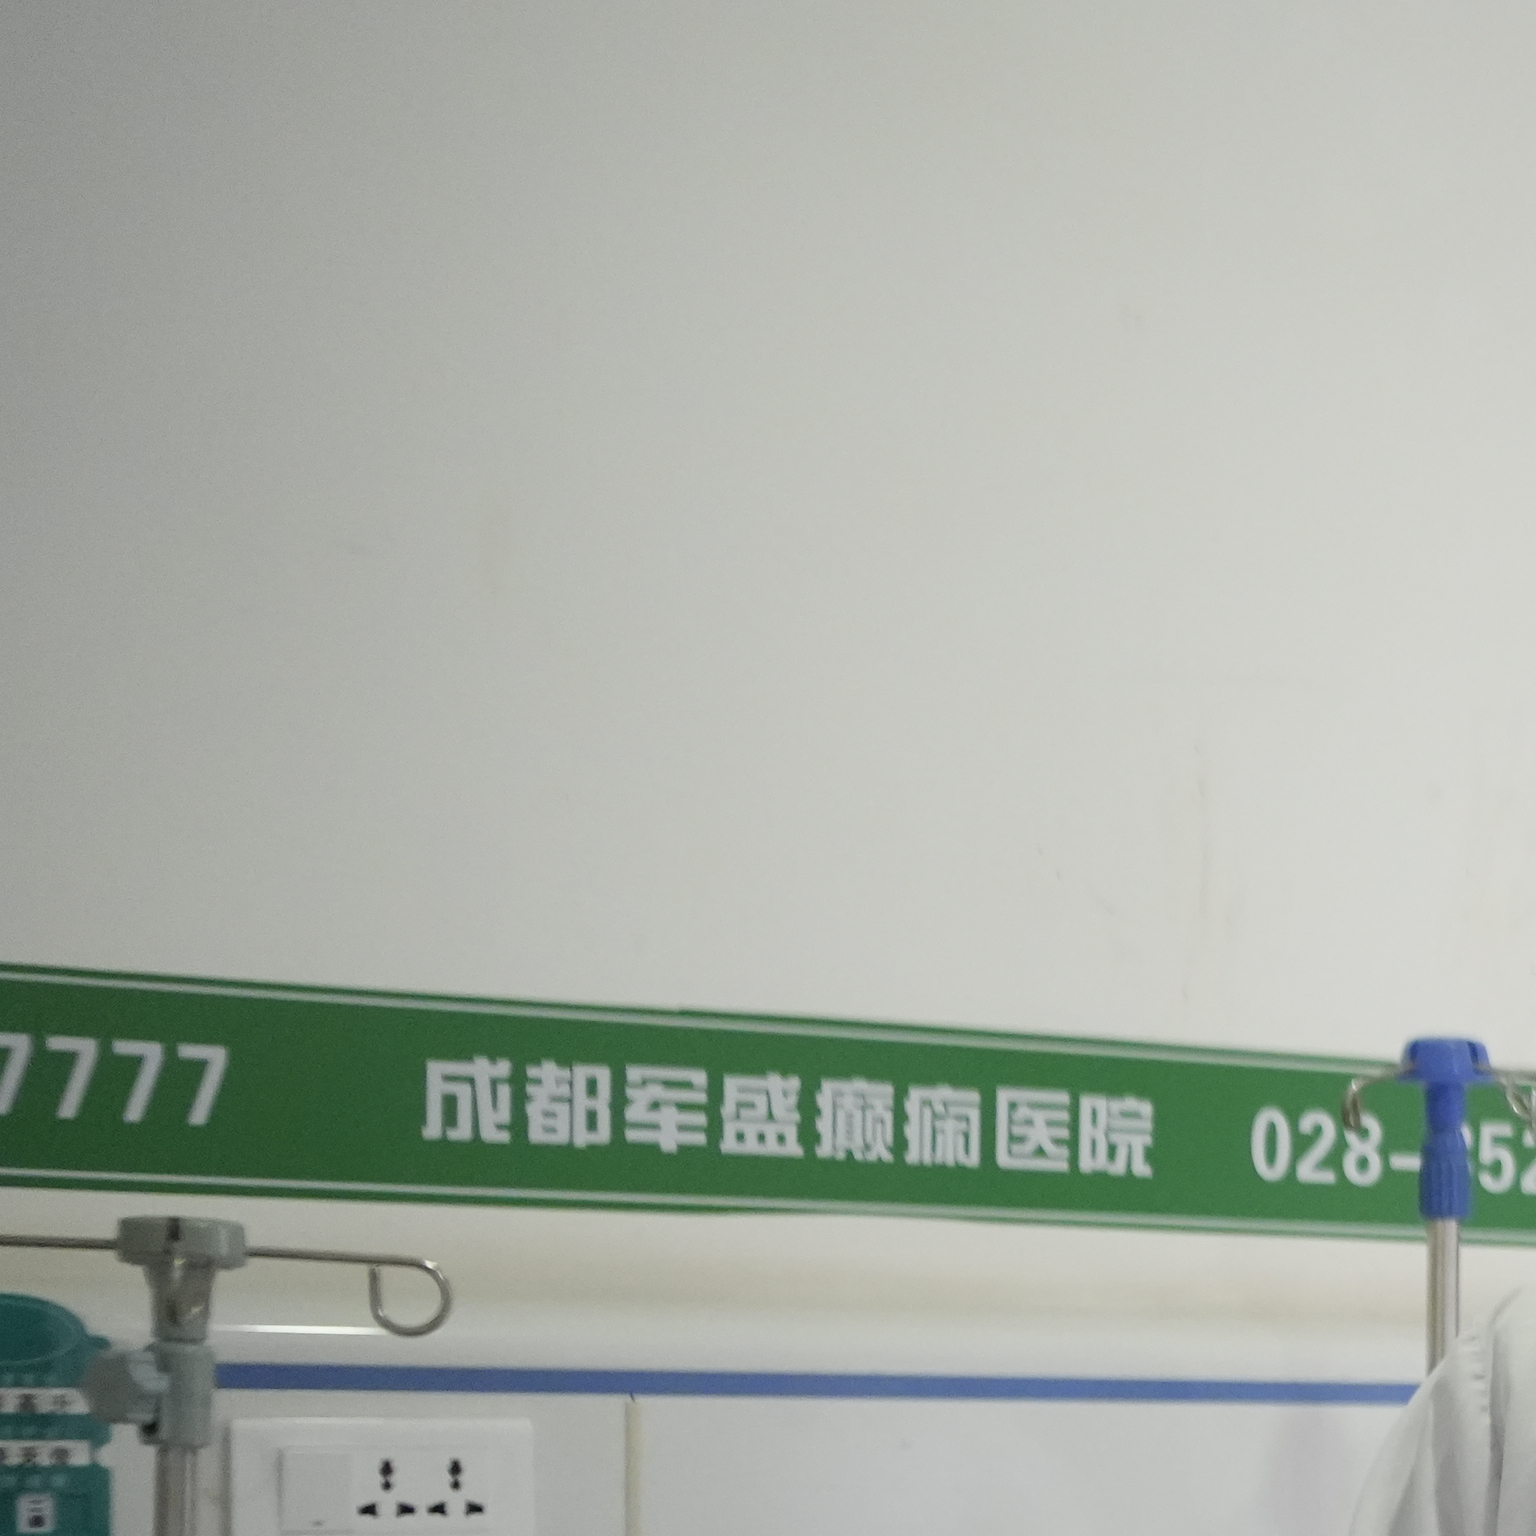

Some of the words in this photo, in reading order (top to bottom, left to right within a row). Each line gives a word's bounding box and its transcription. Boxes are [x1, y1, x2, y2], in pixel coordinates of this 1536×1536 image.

[421, 1054, 1154, 1179] 成都军盛癫痫医院
